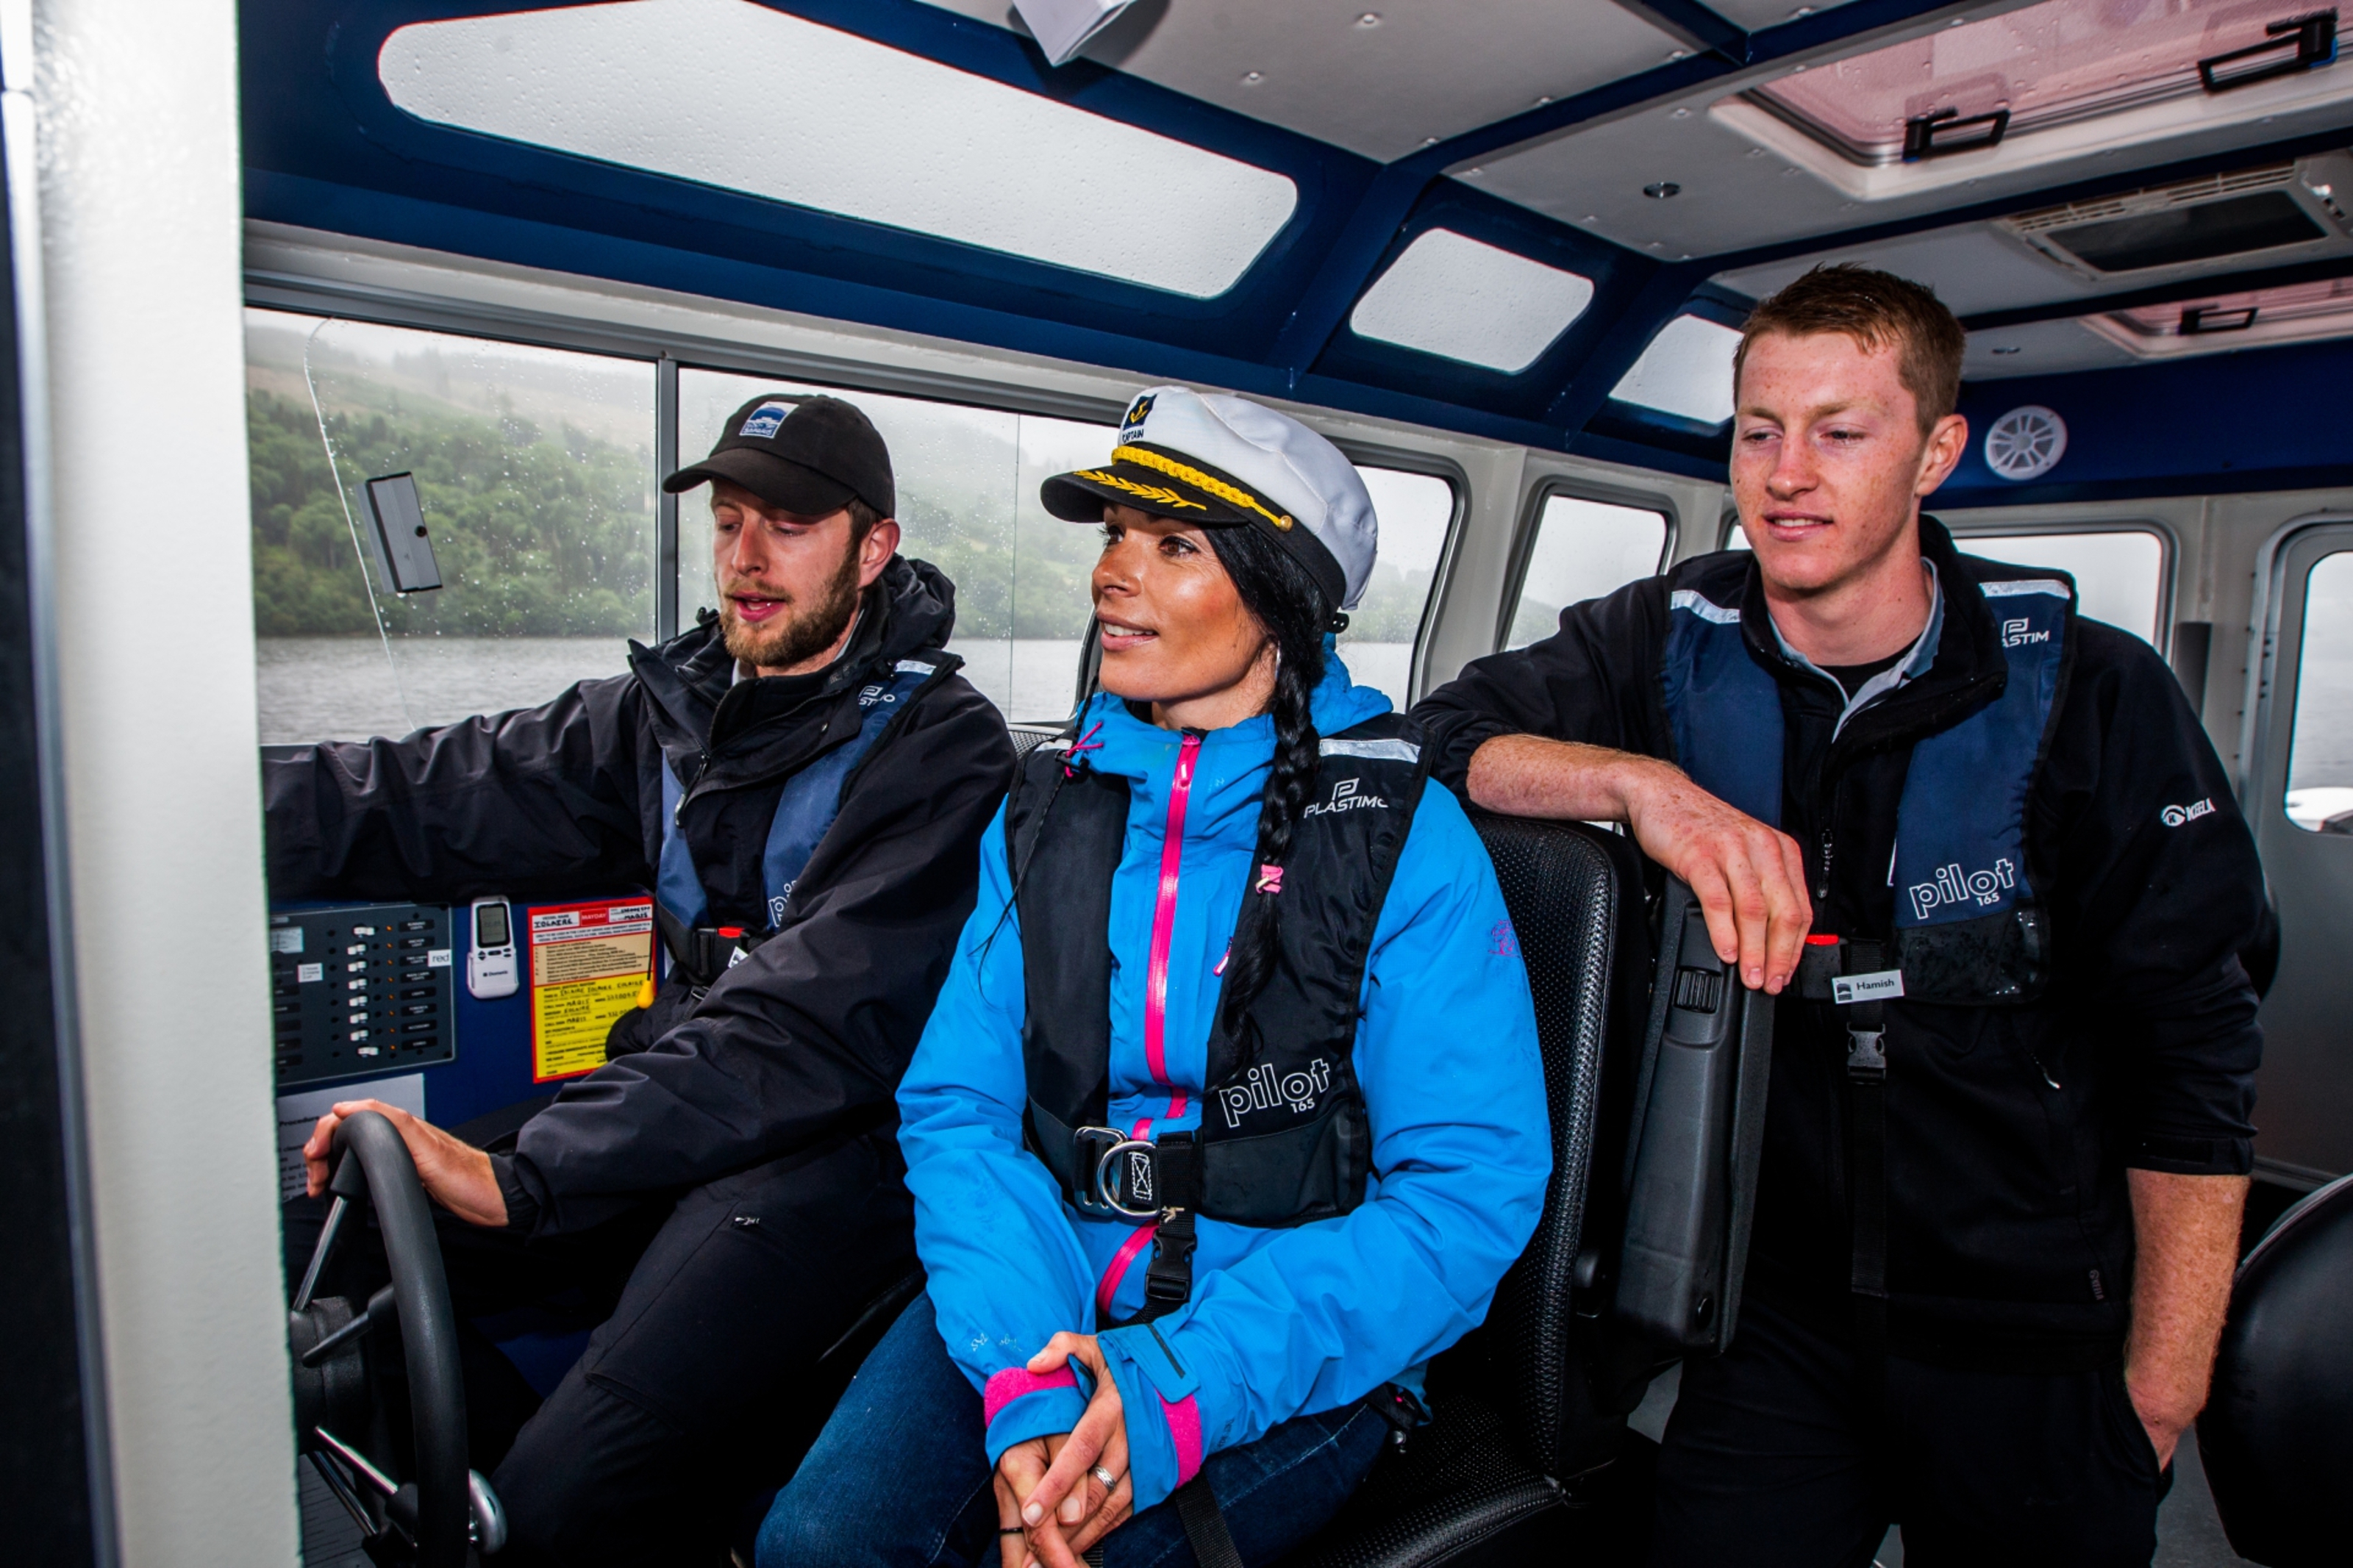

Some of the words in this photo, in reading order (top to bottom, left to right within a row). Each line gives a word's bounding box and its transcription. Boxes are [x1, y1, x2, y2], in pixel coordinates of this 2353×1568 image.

[1122, 429, 1144, 443] CAPTAIN
[2185, 797, 2216, 822] KEELA
[1909, 858, 2015, 920] pilot
[1977, 892, 2000, 906] 165
[432, 953, 450, 962] red
[1856, 978, 1895, 990] Hamish
[1218, 1058, 1330, 1128] pilot
[1290, 1098, 1315, 1114] 165
